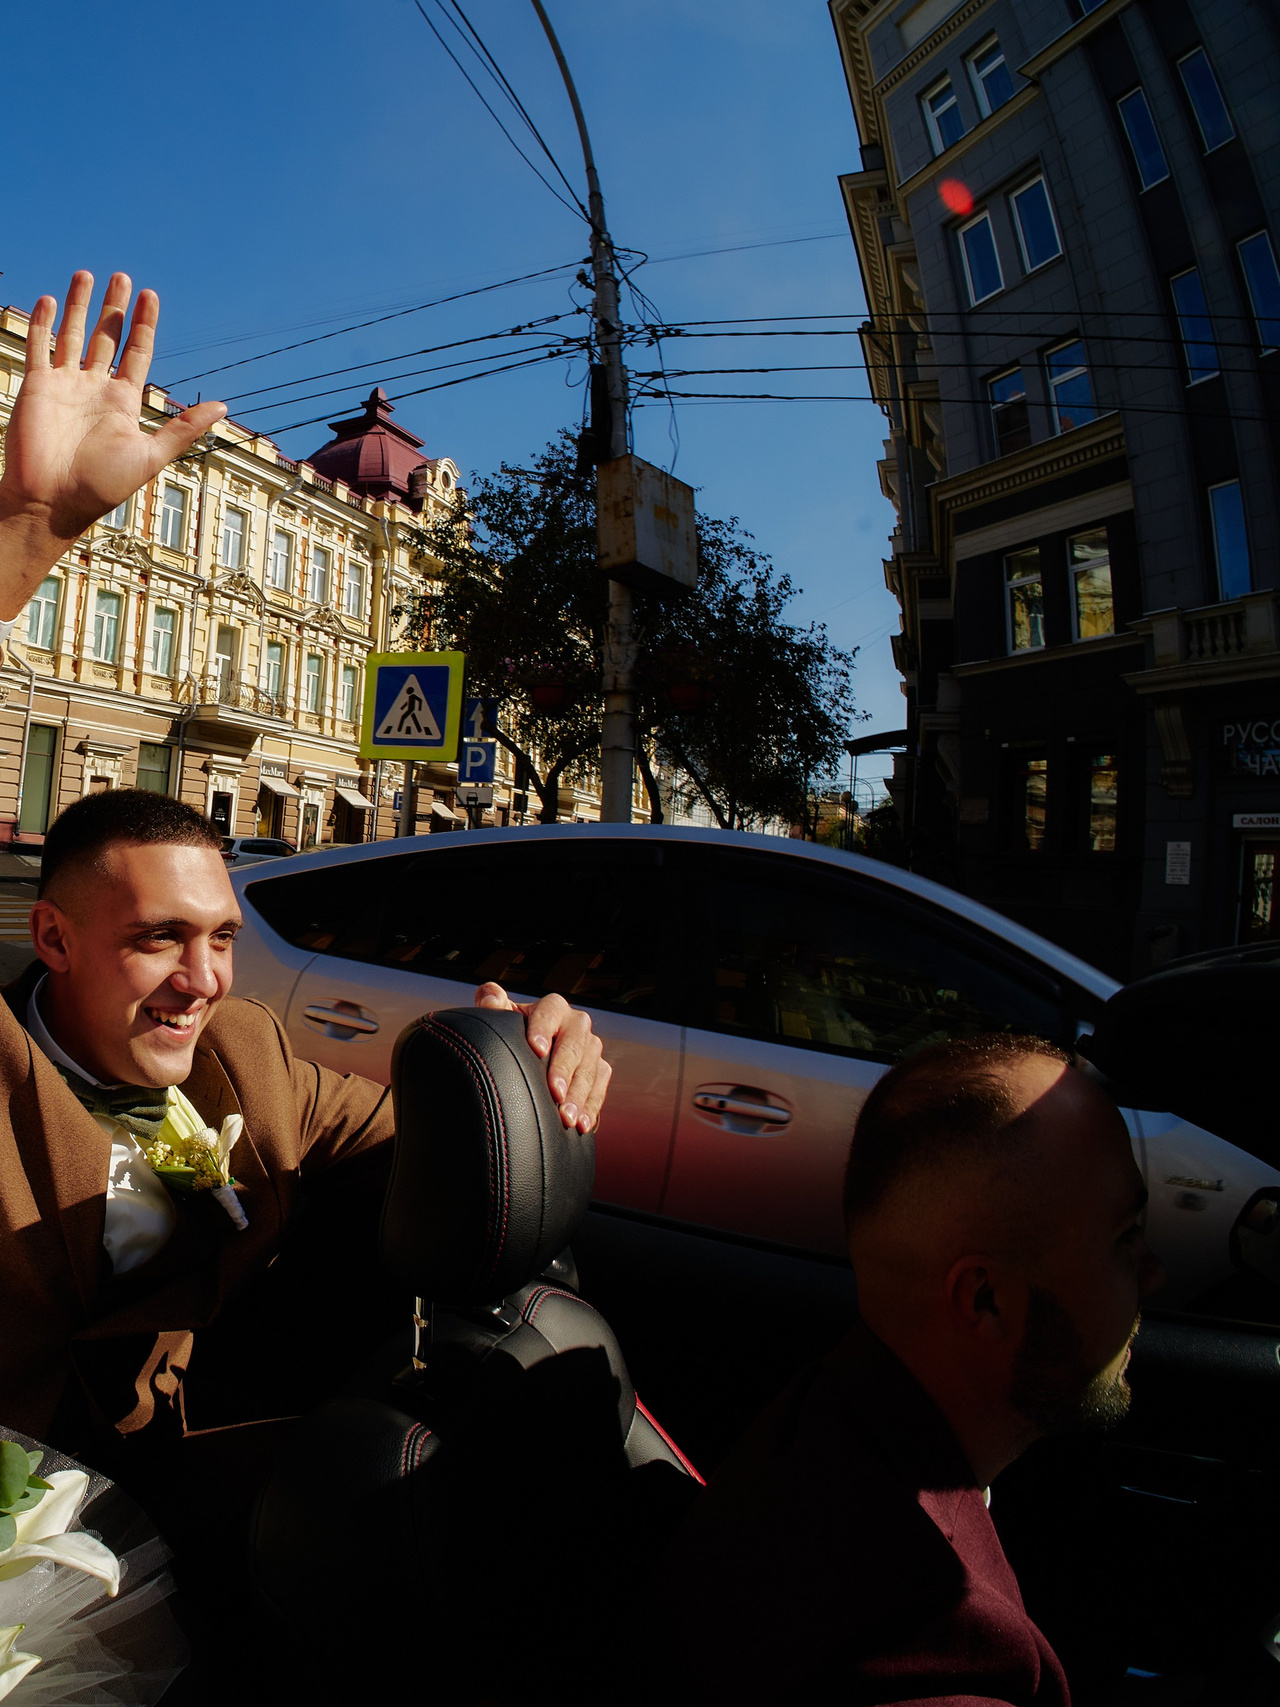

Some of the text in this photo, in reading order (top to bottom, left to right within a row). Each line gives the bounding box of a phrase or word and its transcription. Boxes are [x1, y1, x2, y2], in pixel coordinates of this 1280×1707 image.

[465, 747, 486, 778] P
[260, 765, 284, 777] MaxMara
[1240, 816, 1279, 825] САЛОН
